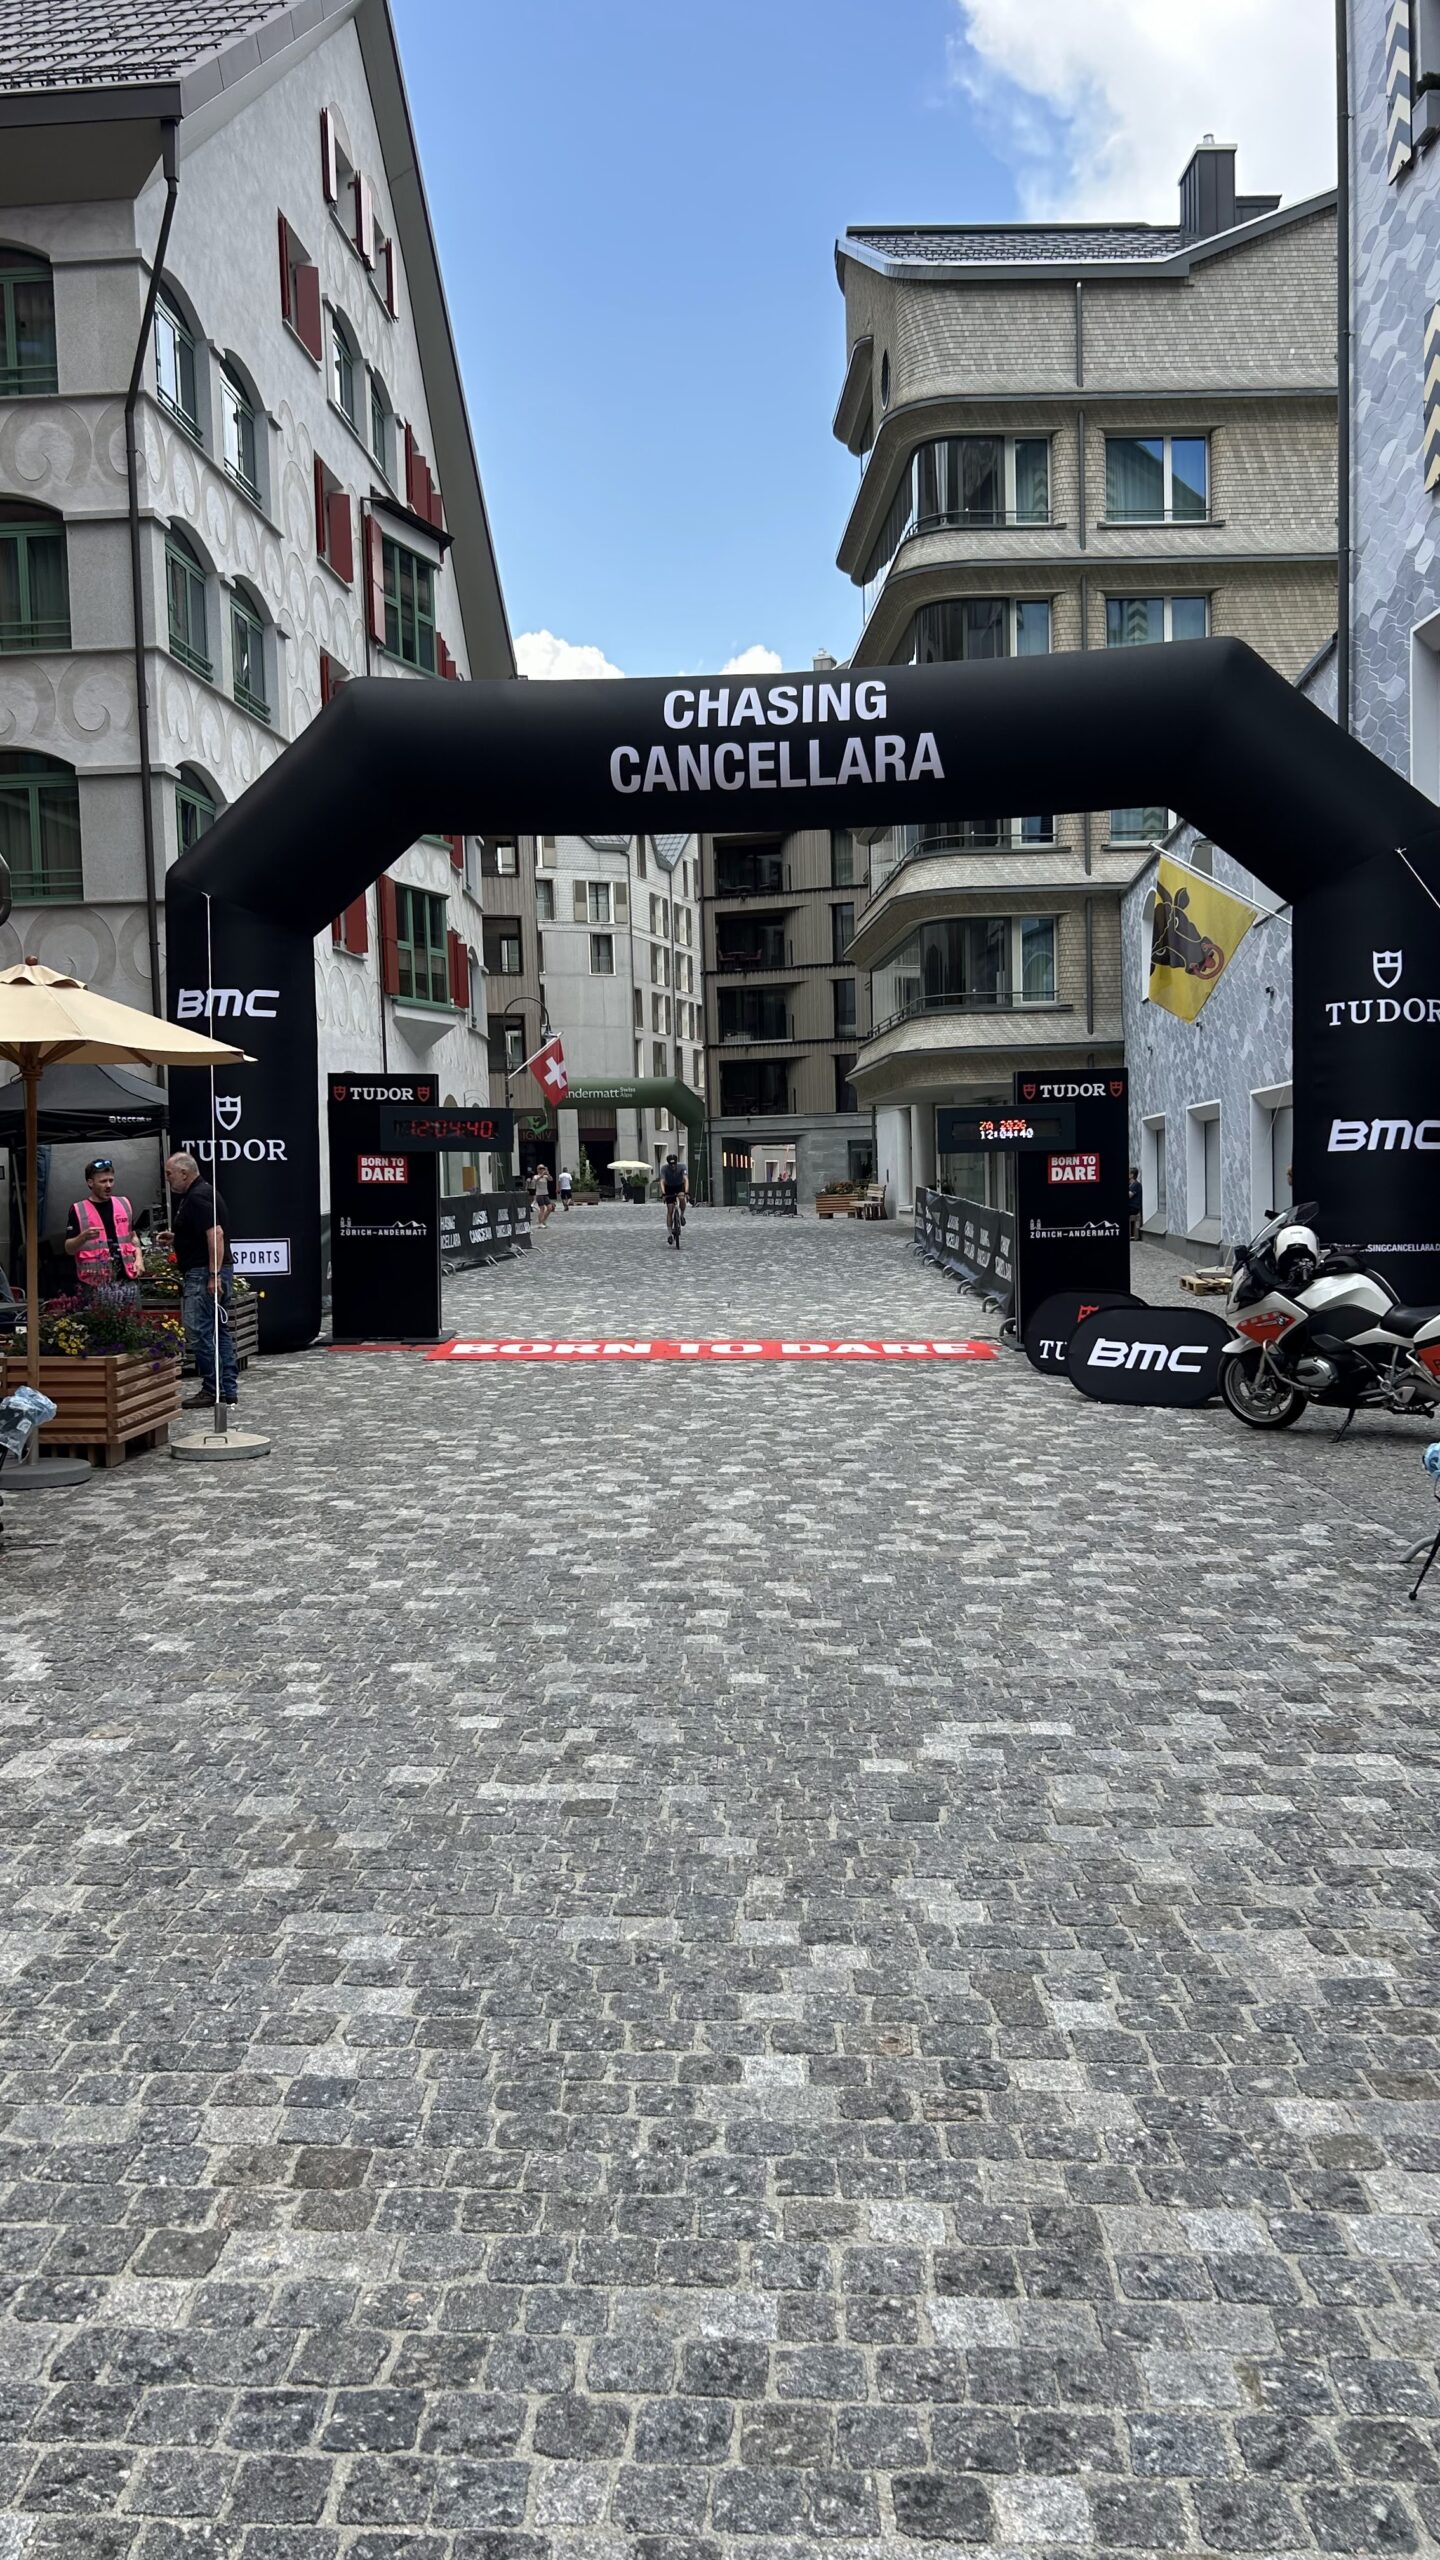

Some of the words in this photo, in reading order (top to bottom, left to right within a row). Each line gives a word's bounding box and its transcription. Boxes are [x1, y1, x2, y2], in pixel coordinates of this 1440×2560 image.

[663, 680, 887, 729] CHASING
[610, 732, 945, 794] CANCELLARA
[177, 988, 280, 1018] BMC
[1326, 998, 1440, 1026] TUDOR
[350, 1087, 414, 1101] TUDOR
[566, 1088, 620, 1099] ndermatt
[1040, 1083, 1106, 1098] TUDOR
[410, 1119, 494, 1138] 12:04:40
[1000, 1119, 1027, 1131] 2026
[980, 1128, 1034, 1139] 12:04:40
[1327, 1118, 1440, 1152] BMC
[182, 1138, 288, 1162] TUDOR
[361, 1157, 389, 1167] BORN
[391, 1157, 404, 1167] TO
[1051, 1156, 1080, 1166] BORN
[1082, 1155, 1096, 1165] TO
[361, 1167, 405, 1181] DARE
[1051, 1166, 1097, 1182] DARE
[450, 1343, 652, 1355] BORN
[668, 1343, 763, 1355] TO
[781, 1343, 976, 1355] DARE
[1086, 1337, 1209, 1373] BMC
